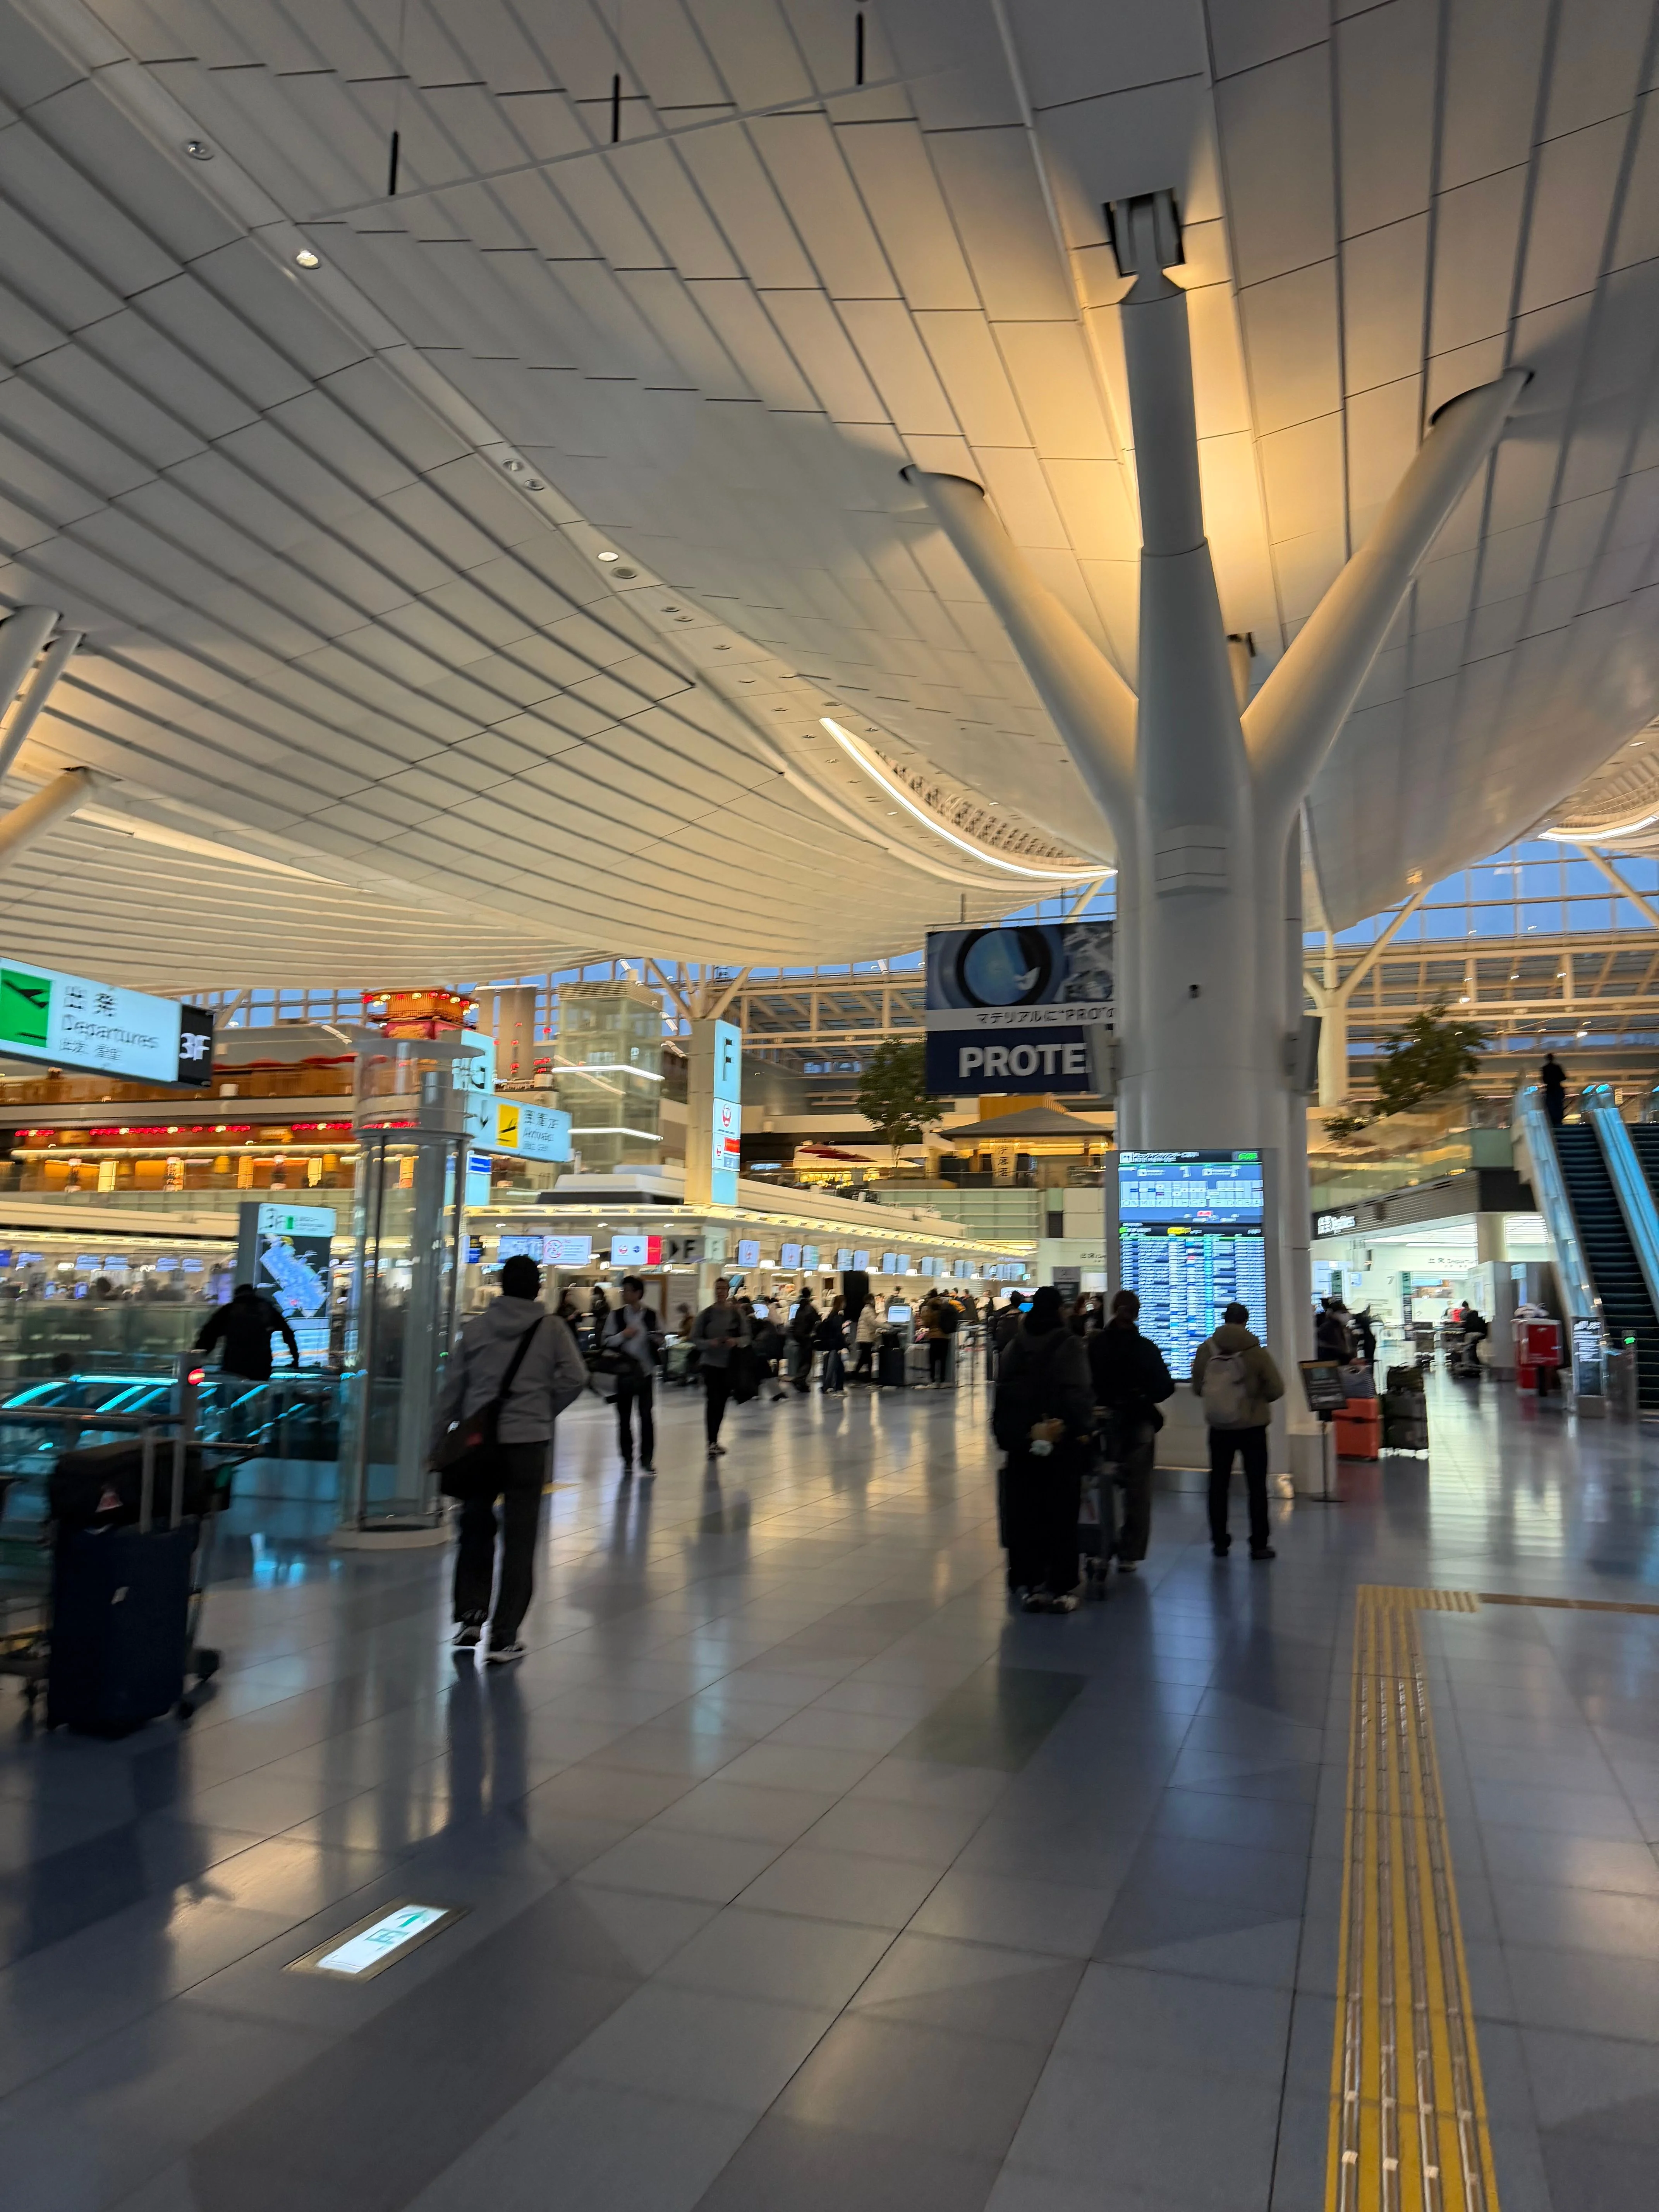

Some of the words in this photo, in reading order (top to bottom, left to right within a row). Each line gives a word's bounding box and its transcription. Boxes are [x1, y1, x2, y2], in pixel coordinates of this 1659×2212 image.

[62, 1014, 160, 1048] Departures
[179, 1032, 211, 1061] 3F
[723, 1037, 735, 1081] F
[684, 1239, 696, 1259] F
